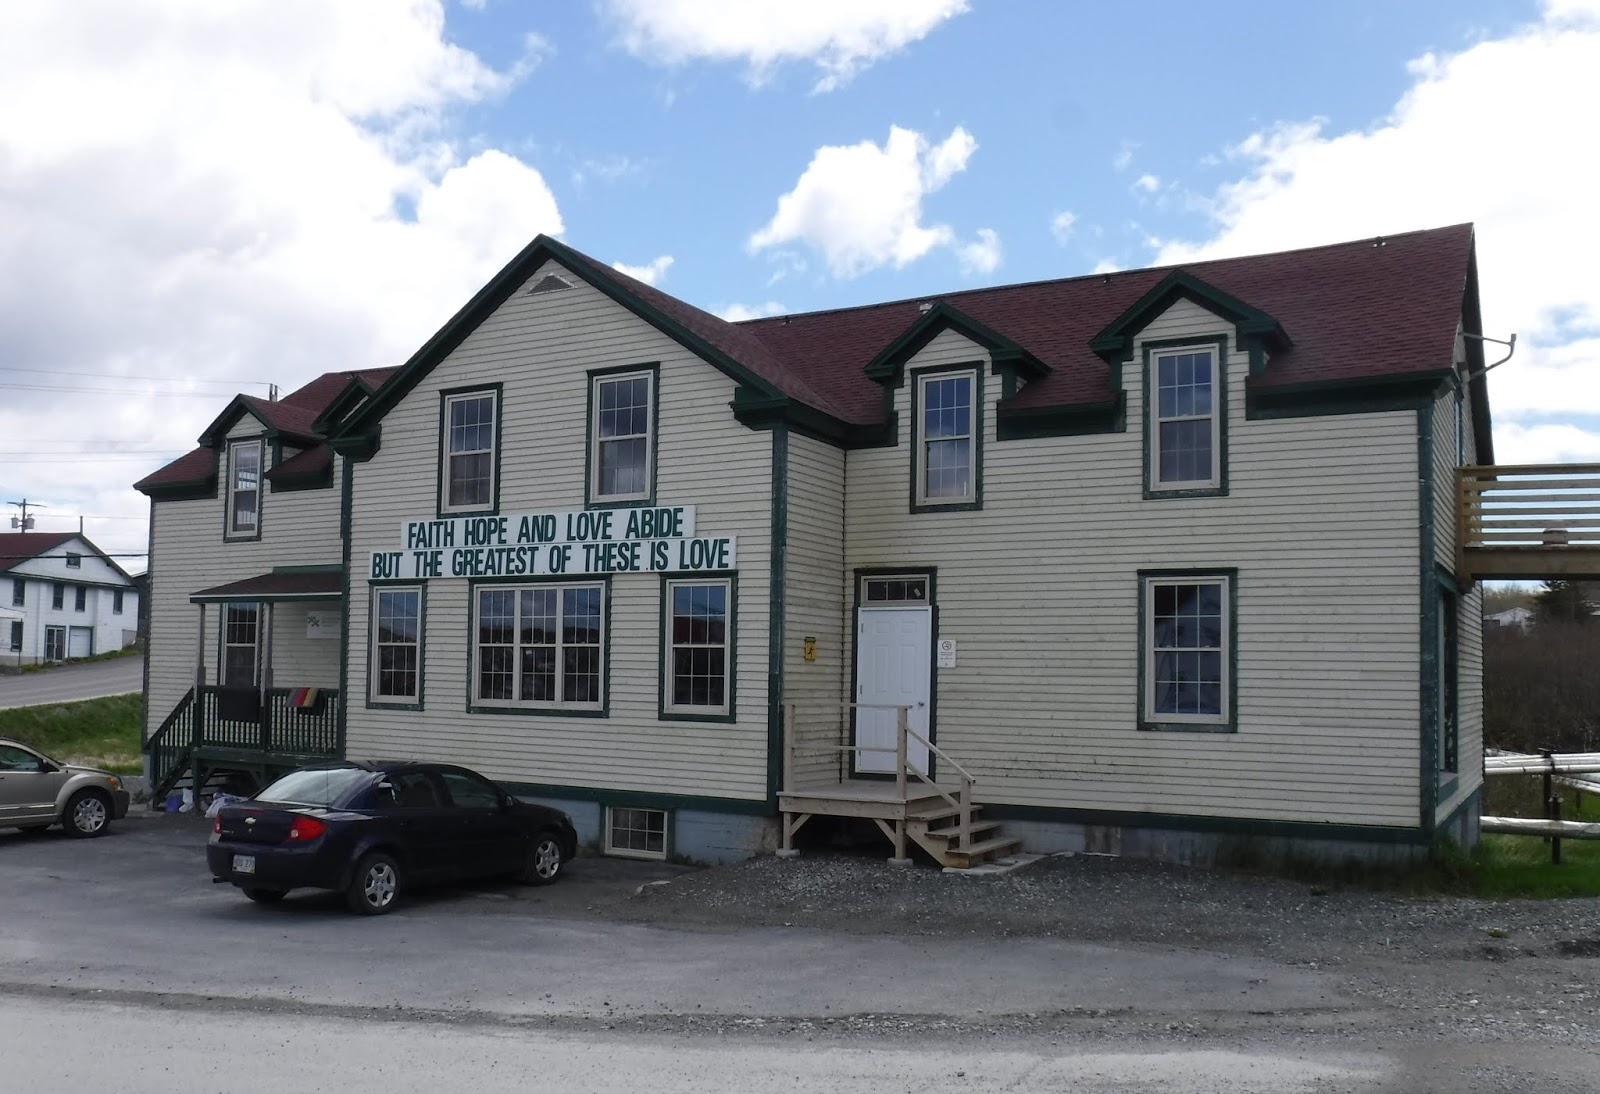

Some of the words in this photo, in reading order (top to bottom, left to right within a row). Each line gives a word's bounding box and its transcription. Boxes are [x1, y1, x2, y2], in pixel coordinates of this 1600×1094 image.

[408, 522, 454, 549] FAITH
[465, 517, 508, 545] HOPE
[517, 514, 556, 543] AND
[566, 512, 613, 542] LOVE
[624, 508, 684, 539] ABIDE
[372, 553, 403, 578] BUT
[413, 551, 443, 577] THE
[452, 547, 538, 575] GREATEST
[549, 545, 572, 573] OF
[583, 542, 640, 571] THESE
[649, 541, 668, 570] IS
[679, 538, 729, 569] LOVE
